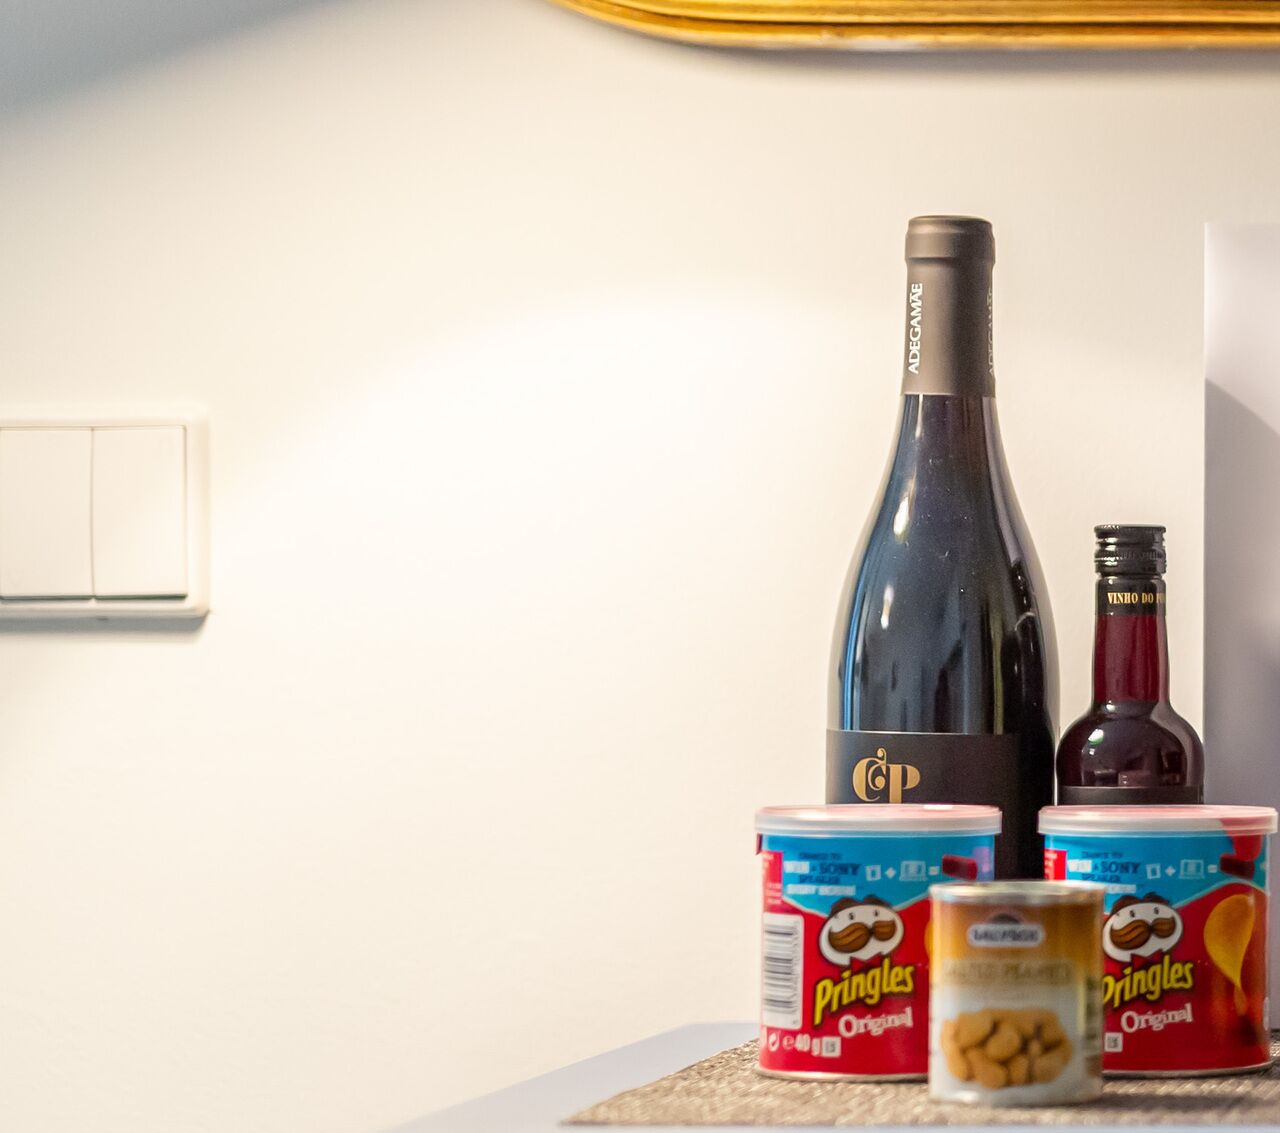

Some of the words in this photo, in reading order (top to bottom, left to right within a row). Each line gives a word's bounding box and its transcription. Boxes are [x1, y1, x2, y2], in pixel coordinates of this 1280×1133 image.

[908, 283, 923, 374] ADEGAMÃE
[1107, 592, 1138, 604] VINHO
[1141, 592, 1154, 604] DO
[813, 957, 915, 1026] Pringles
[838, 1005, 914, 1038] Original
[1121, 1002, 1194, 1034] Original
